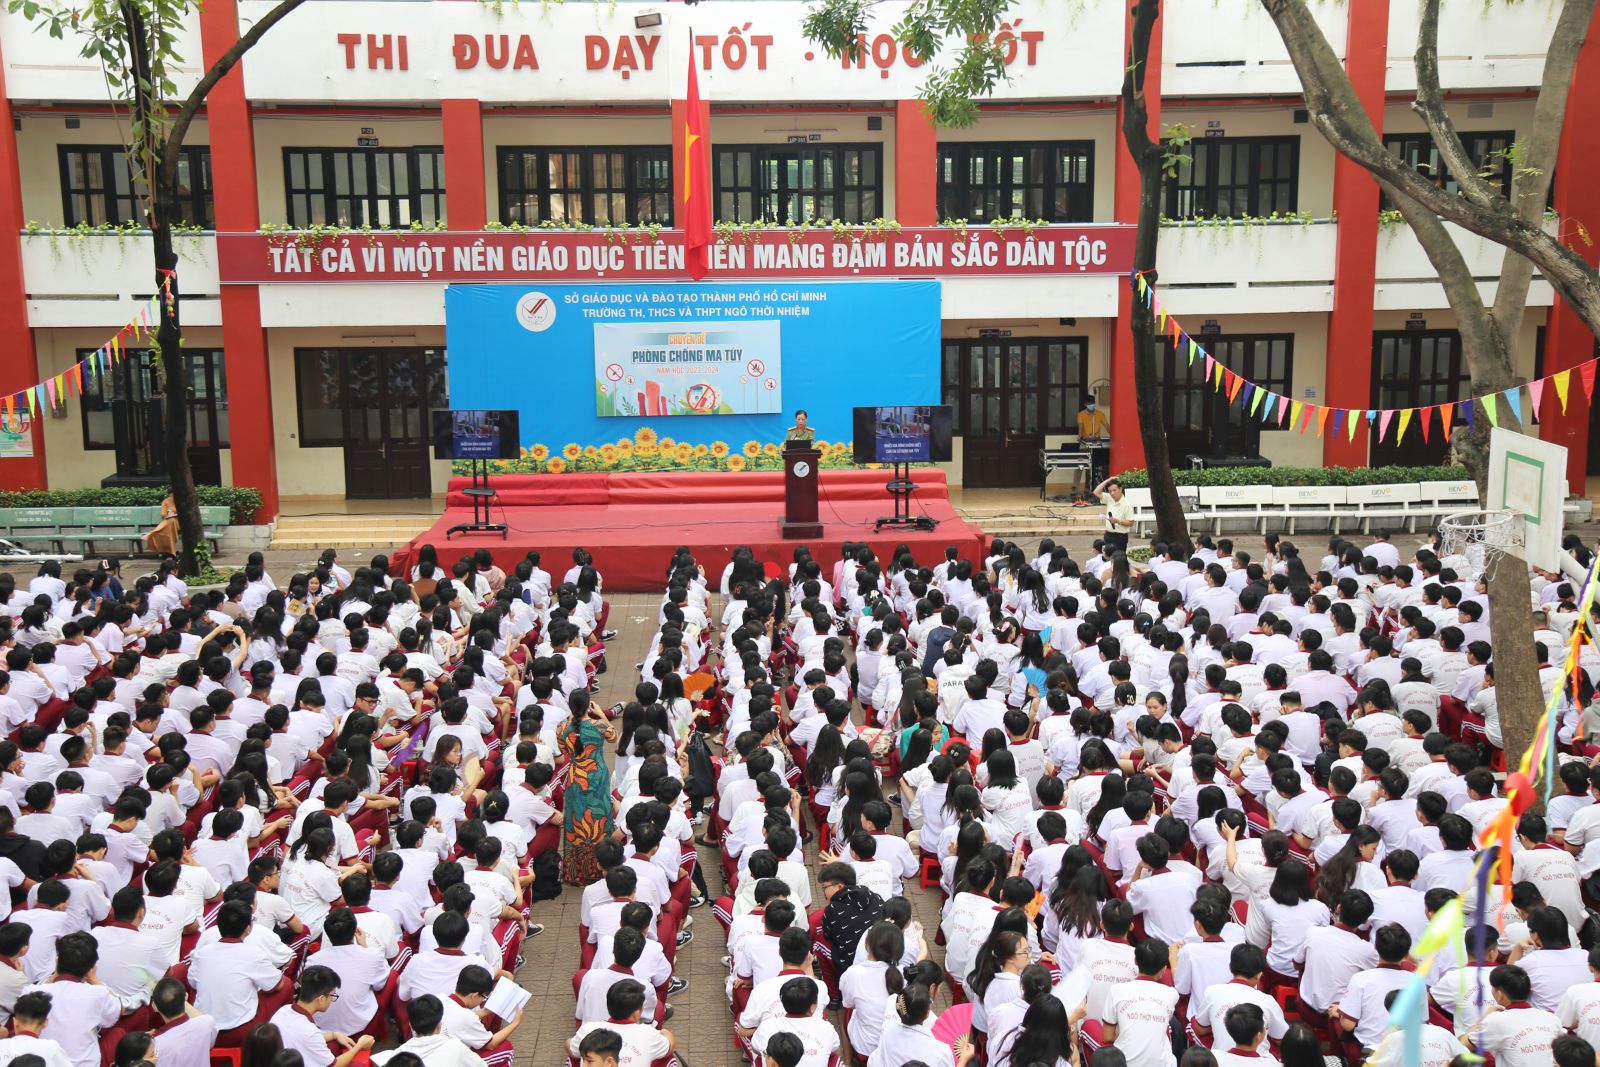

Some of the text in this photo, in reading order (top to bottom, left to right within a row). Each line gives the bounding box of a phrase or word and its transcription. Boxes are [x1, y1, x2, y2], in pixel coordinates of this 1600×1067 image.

[337, 33, 409, 71] THI
[452, 34, 539, 70] ĐUA
[585, 35, 661, 80] DẠY
[695, 22, 773, 71] TỐT
[966, 18, 1044, 67] ỐT
[270, 238, 314, 272] TẤT
[322, 238, 356, 273] CẢ
[361, 241, 386, 273] VÌ
[393, 241, 446, 277] MỘT
[453, 237, 504, 272] NỀN
[511, 240, 568, 271] GIÁO
[576, 245, 625, 276] DỤC
[632, 239, 685, 271] TIÊN
[753, 243, 825, 270] MANG
[832, 238, 887, 273] ĐẬM
[894, 233, 943, 267] BẢN
[951, 232, 998, 267] SẮC
[1006, 235, 1055, 266] DÂN
[1062, 235, 1107, 271] TỘC
[563, 289, 827, 305] SỞ GIÁO DỤC VÀ ĐÀO TẠO THÀNH PHỐ HỒ CHÍ MINH
[582, 305, 810, 318] TRƯỜNG TH, THCS VÀ THPT NGÔ THỜI NHIỆM
[669, 333, 694, 345] CHUYÊN
[632, 346, 743, 363] PHÒNG CHỐNG MA TÚY
